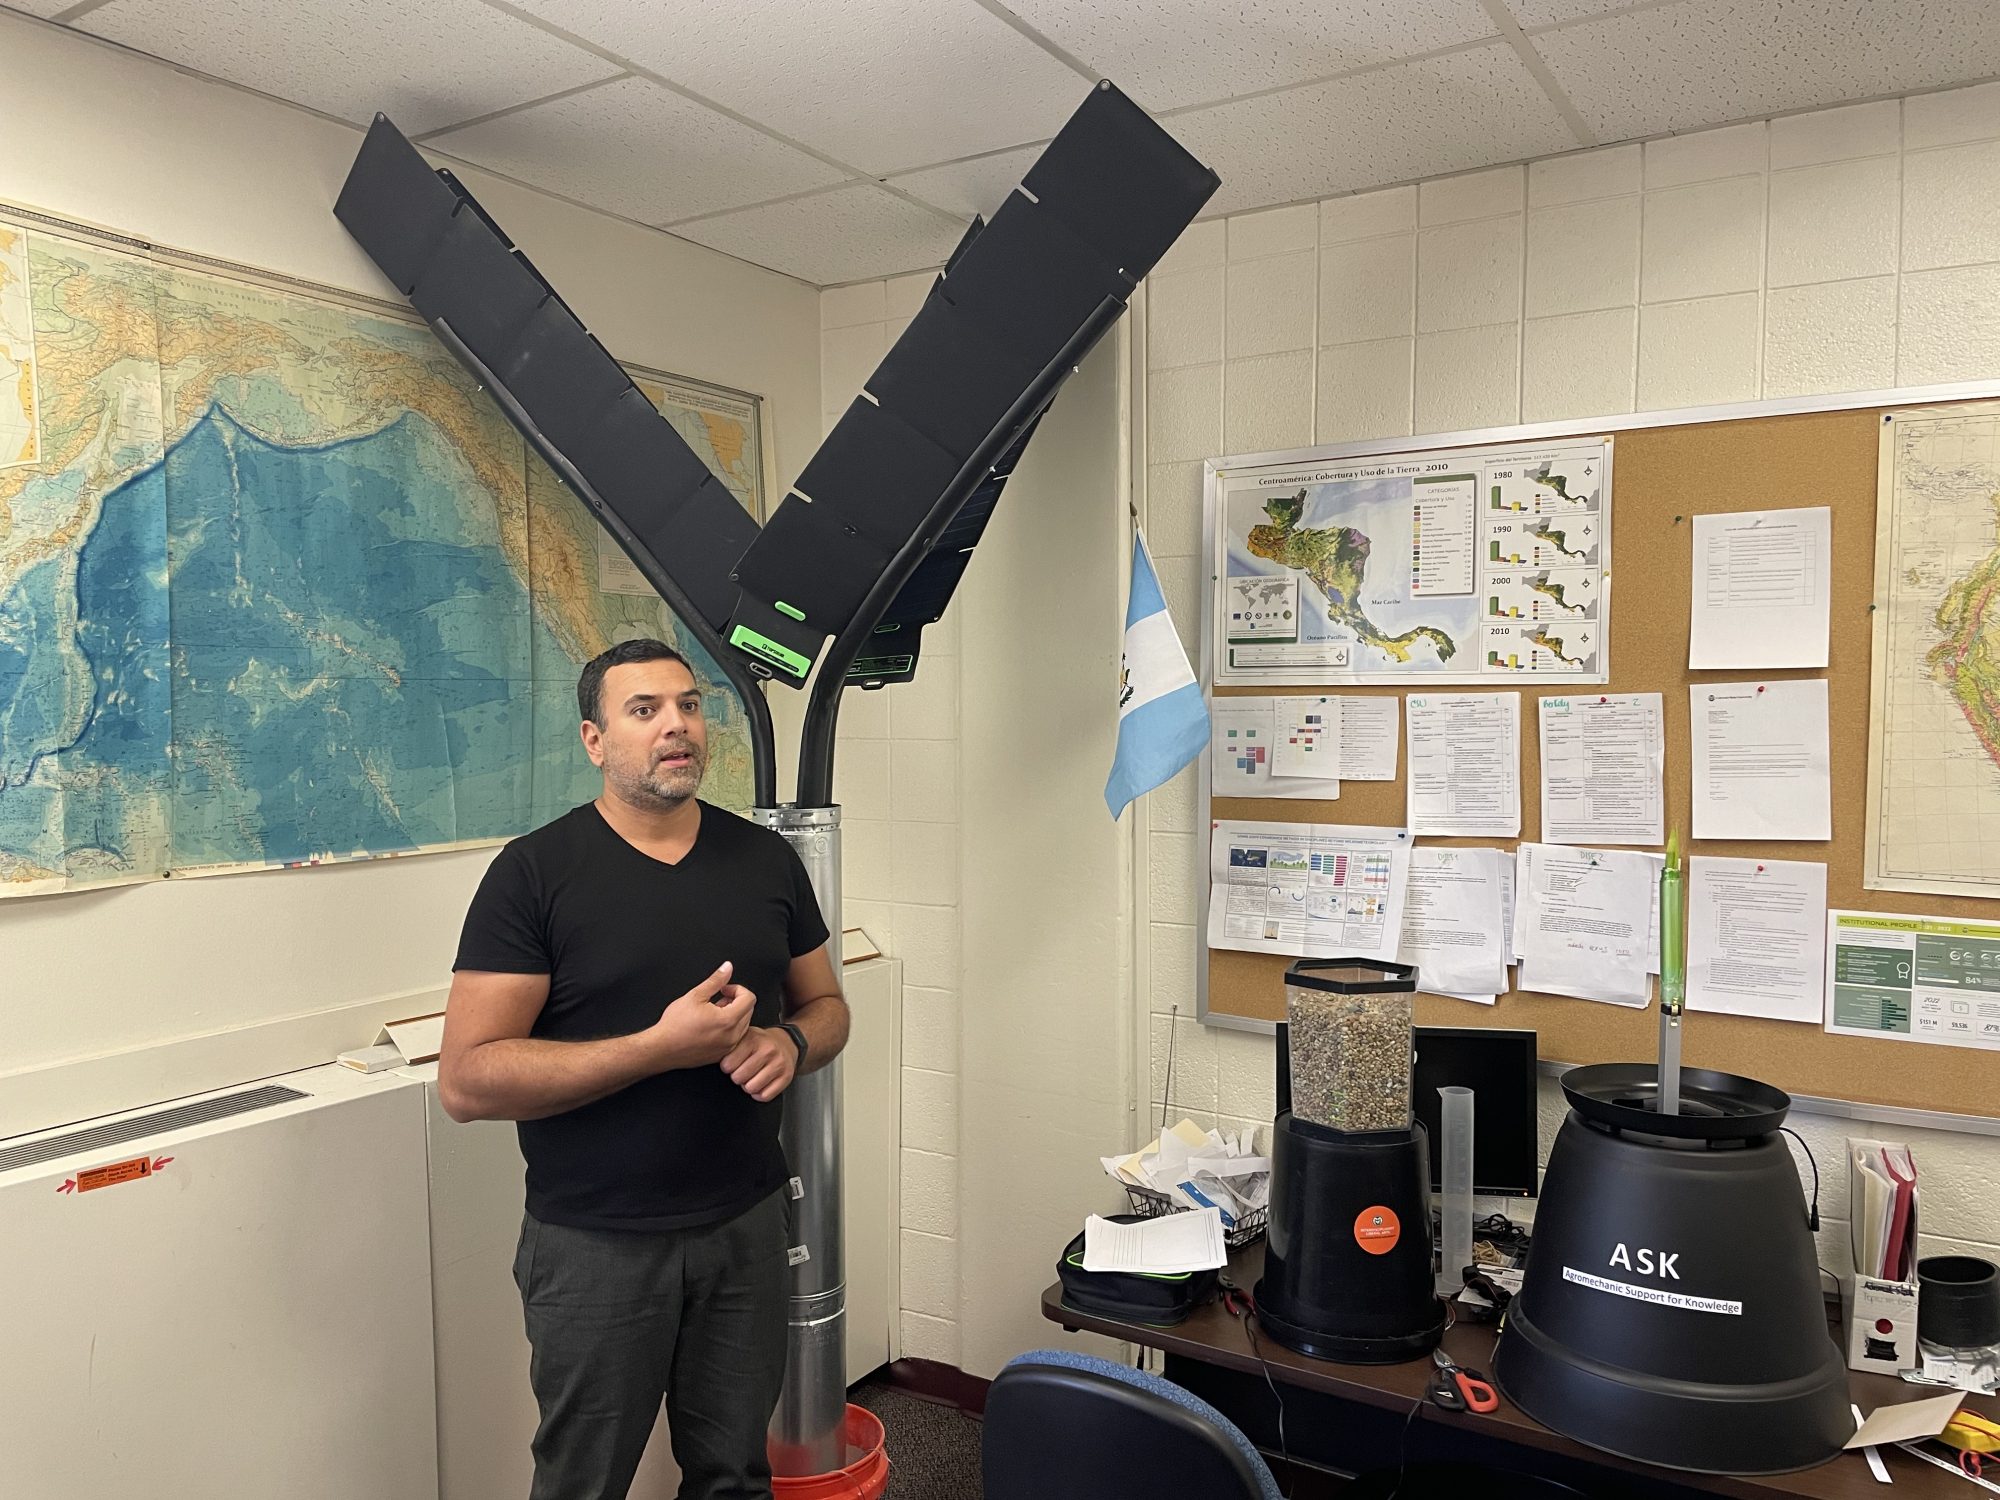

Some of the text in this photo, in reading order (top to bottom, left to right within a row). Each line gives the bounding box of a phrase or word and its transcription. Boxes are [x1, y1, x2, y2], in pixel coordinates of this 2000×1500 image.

[1259, 474, 1314, 486] Centroamérica:
[1316, 472, 1353, 481] Cobertura
[1361, 469, 1375, 477] Uso
[1396, 465, 1420, 474] Tierra
[1425, 464, 1448, 472] 2010
[1494, 471, 1512, 479] 1980
[1839, 919, 1889, 927] INSTITUTIONAL
[1608, 1242, 1680, 1280] ASK
[1565, 1269, 1739, 1314] Agromechanic Support for Knowledge
